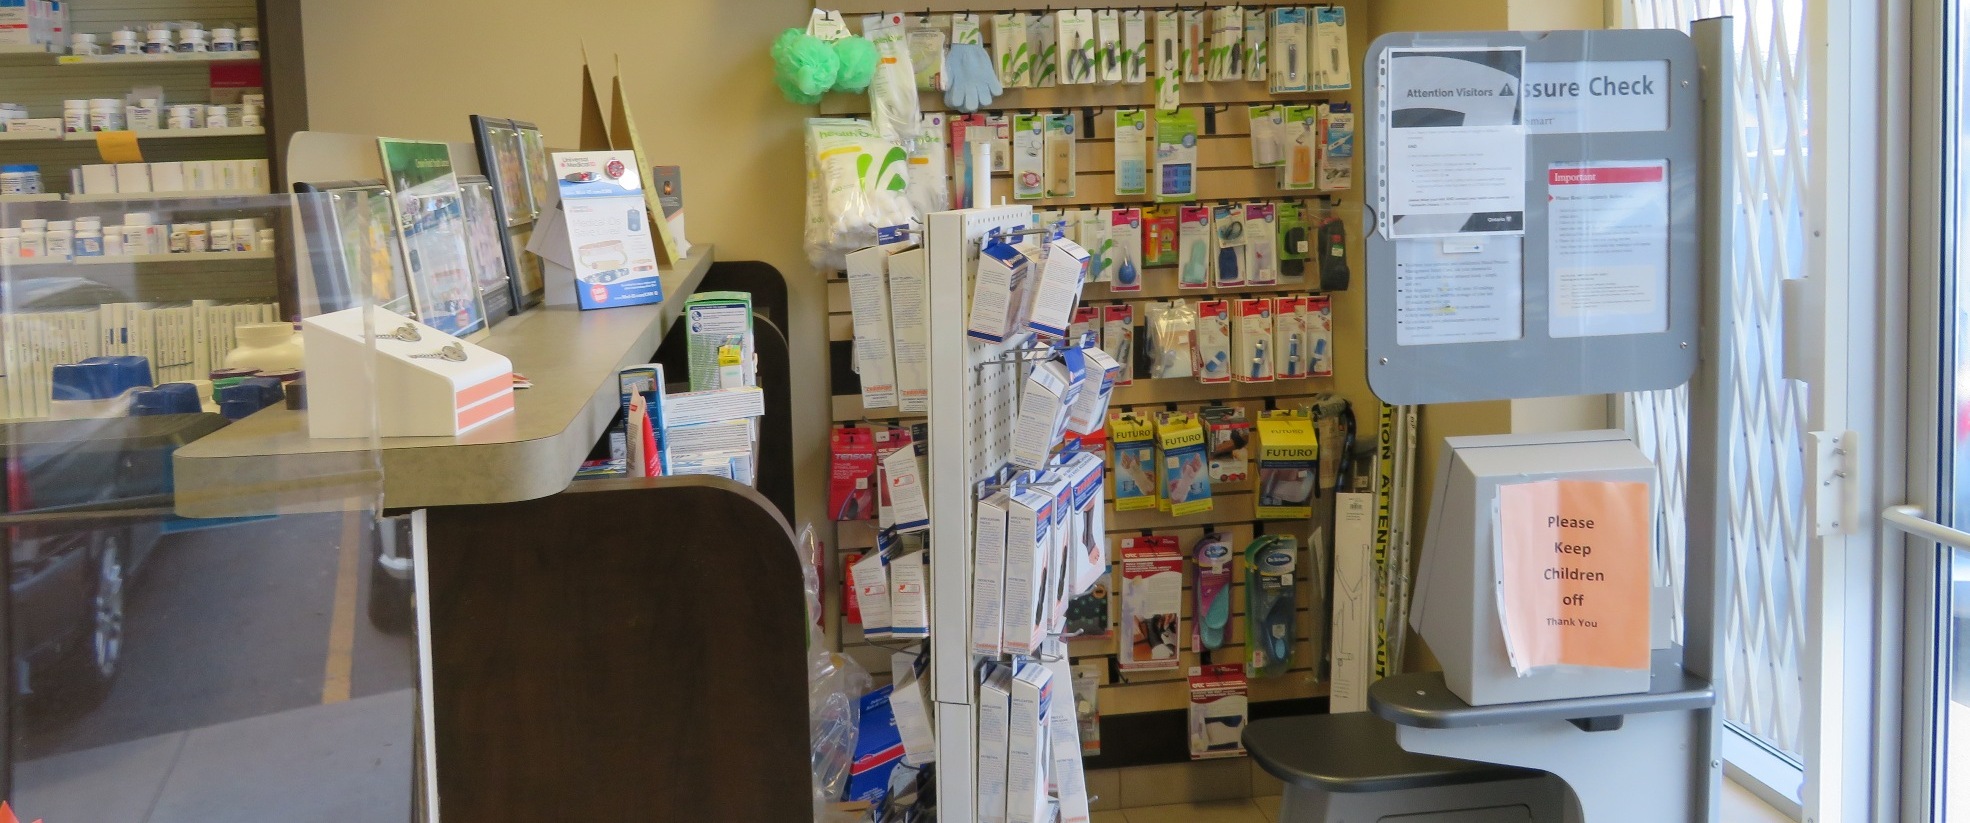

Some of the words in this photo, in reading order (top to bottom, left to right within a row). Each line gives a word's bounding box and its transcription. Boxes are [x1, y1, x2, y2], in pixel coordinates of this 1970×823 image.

[1589, 74, 1654, 96] Check
[1407, 88, 1454, 98] Attention
[1456, 88, 1494, 97] Visitors
[1554, 172, 1596, 184] Important
[1116, 430, 1151, 439] FUTURO
[1165, 433, 1201, 446] FUTURO
[1266, 448, 1313, 457] FUTURO
[1547, 515, 1595, 530] Please
[1377, 475, 1390, 598] ATTENTION
[1554, 542, 1592, 558] Keep
[1543, 566, 1604, 582] Children
[1562, 593, 1584, 607] off
[1546, 617, 1576, 627] Thank
[1578, 618, 1598, 628] You
